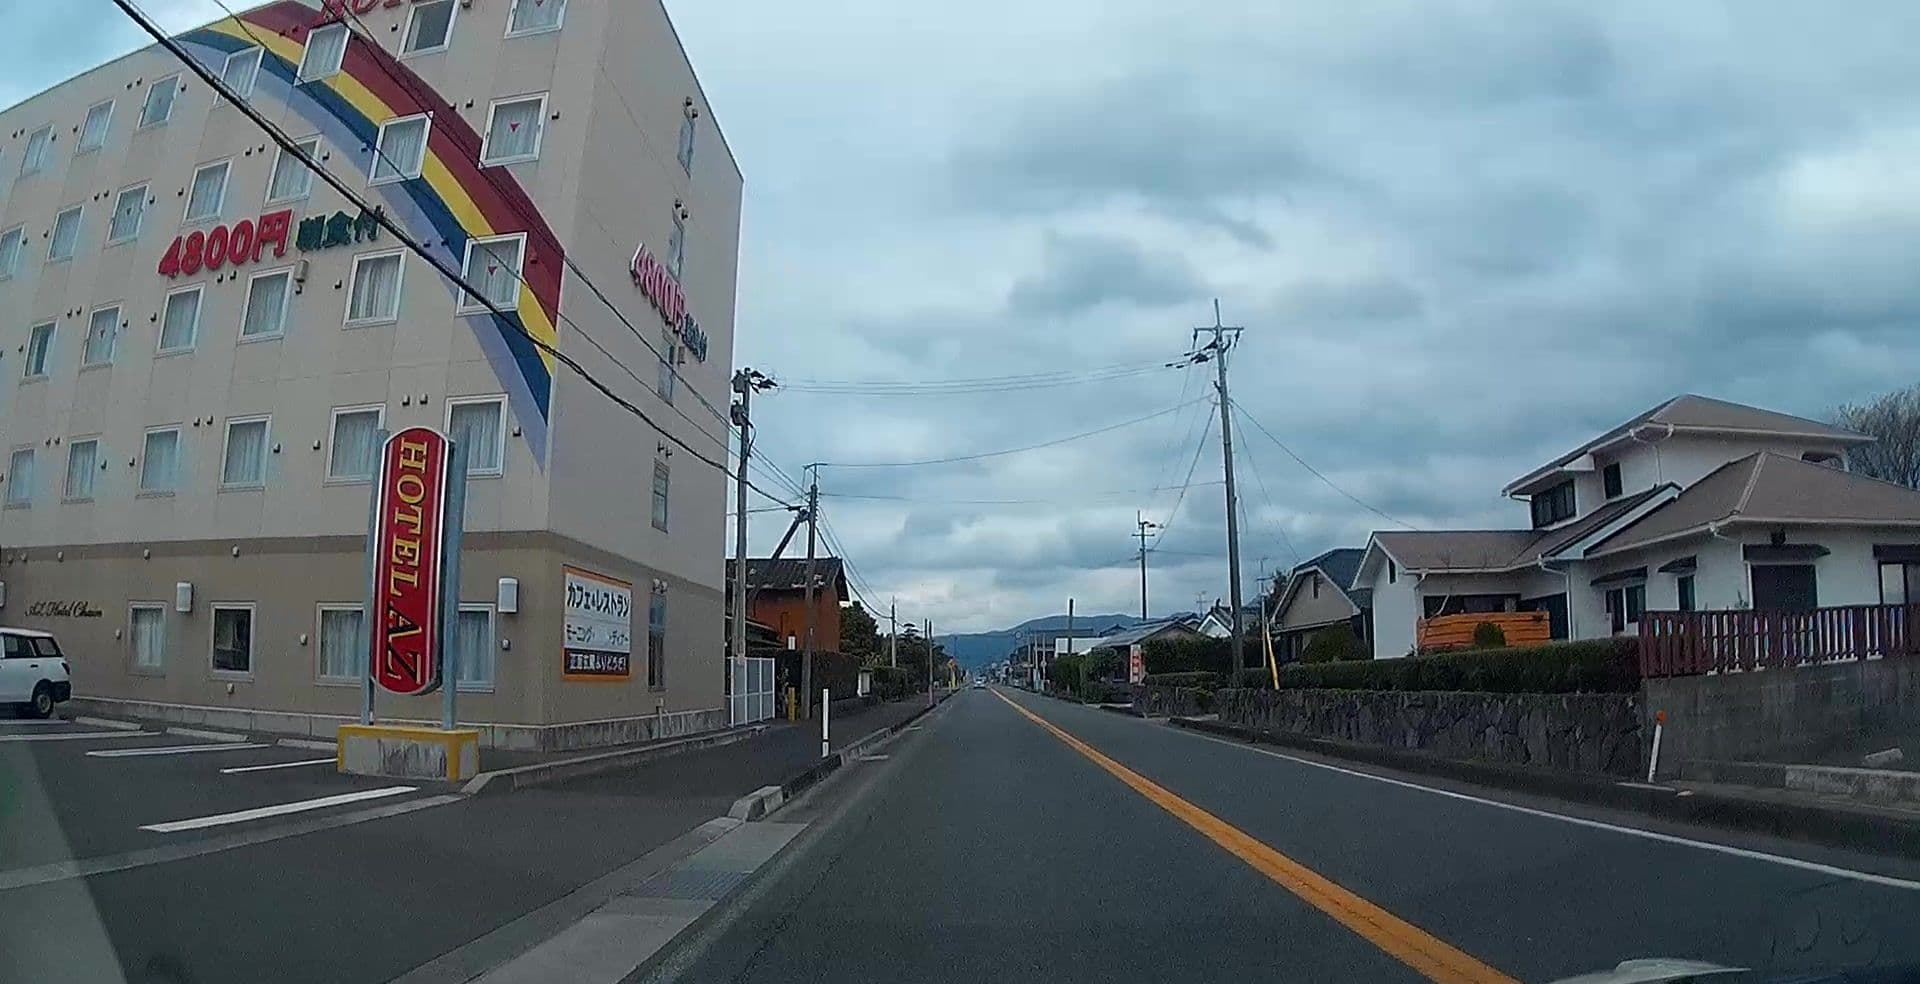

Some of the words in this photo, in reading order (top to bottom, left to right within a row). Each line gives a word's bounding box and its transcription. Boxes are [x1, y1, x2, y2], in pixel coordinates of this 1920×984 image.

[157, 209, 292, 279] 4800円
[390, 437, 428, 597] HOTEL
[387, 603, 423, 685] AZ
